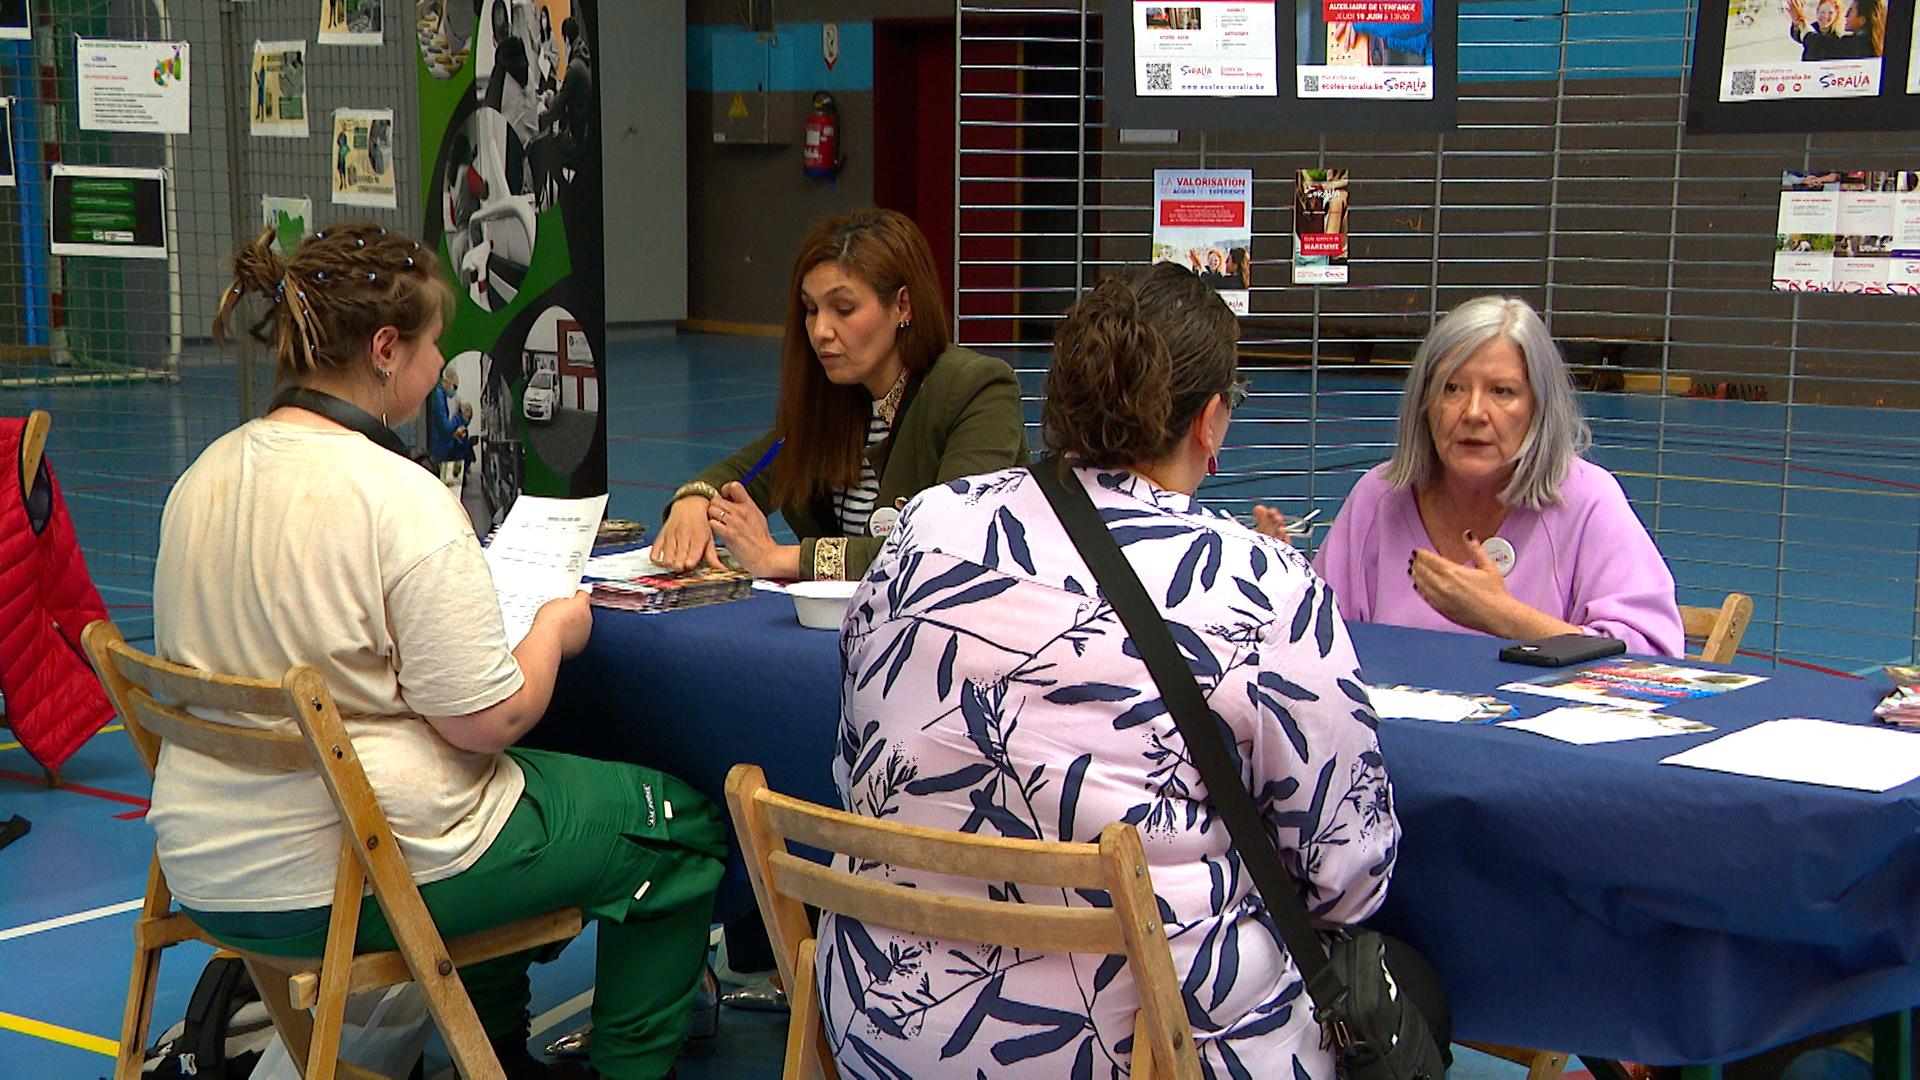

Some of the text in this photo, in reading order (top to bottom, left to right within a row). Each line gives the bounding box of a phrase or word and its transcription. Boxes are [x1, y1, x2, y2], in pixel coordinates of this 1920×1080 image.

[1819, 72, 1870, 88] SORALIA
[1161, 177, 1245, 187] LA VALORISATION
